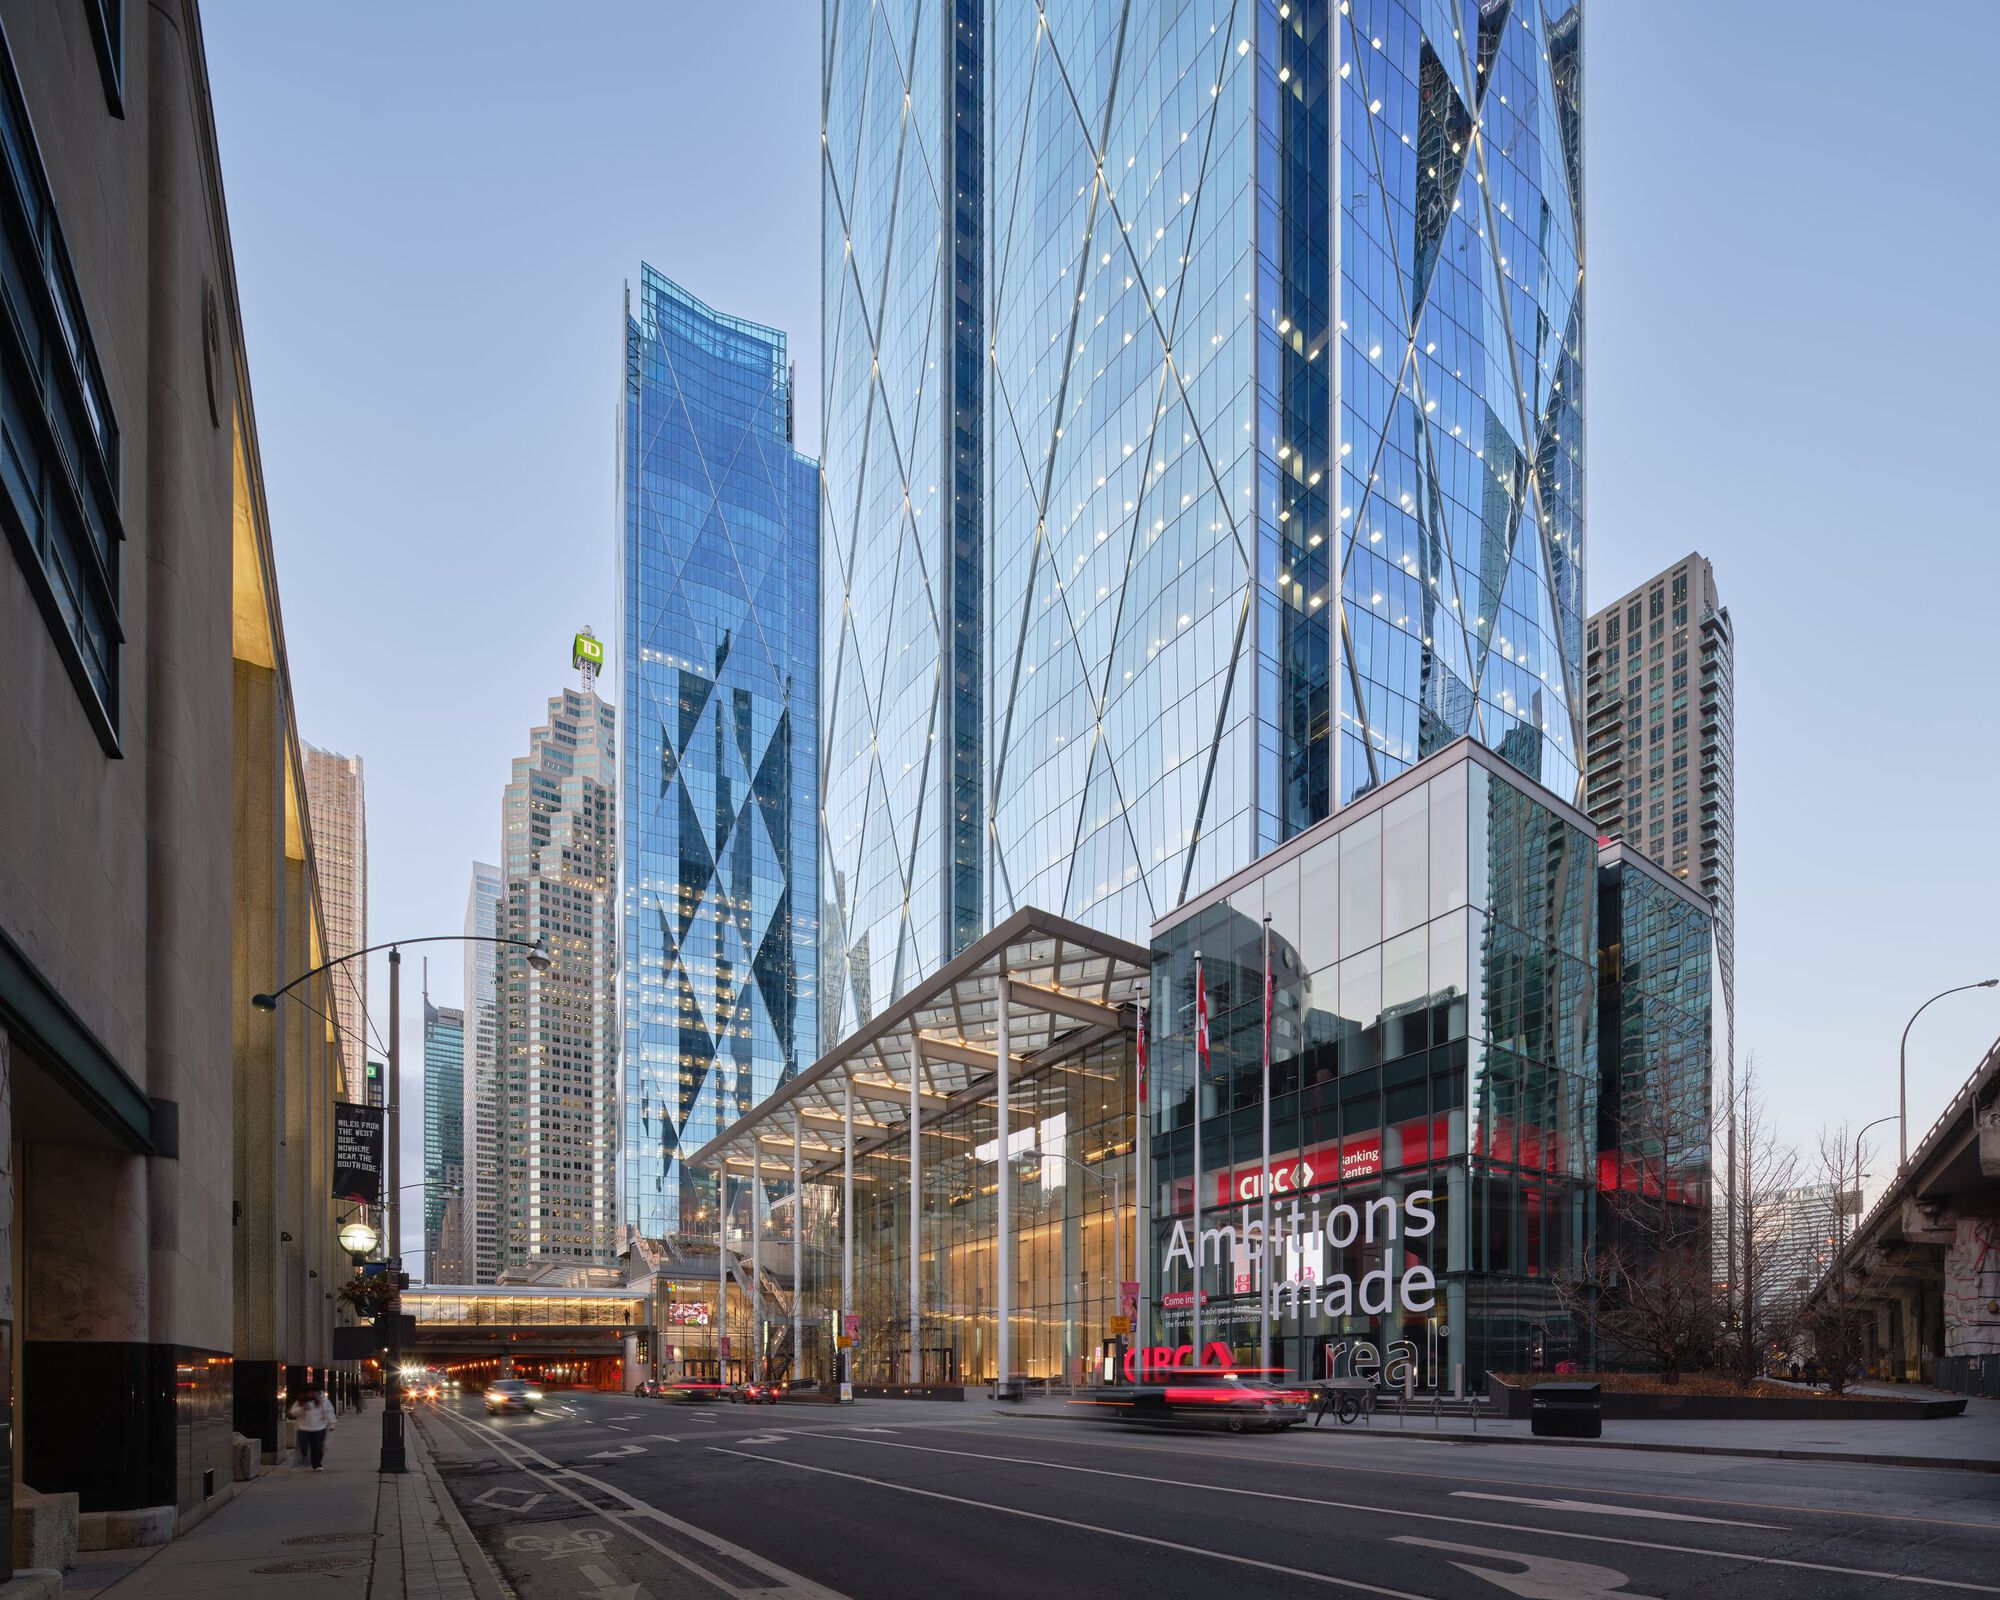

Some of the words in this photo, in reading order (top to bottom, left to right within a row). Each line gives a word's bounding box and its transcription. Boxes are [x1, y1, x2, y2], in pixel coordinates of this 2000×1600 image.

[579, 638, 601, 658] TD
[338, 1120, 360, 1128] MILES
[338, 1145, 370, 1154] NOWHERE
[1342, 1149, 1379, 1165] anking
[337, 1161, 360, 1169] SOUTH
[359, 1154, 372, 1162] THE
[1239, 1168, 1289, 1200] CIBC
[1163, 1189, 1436, 1272] Ambitions
[1272, 1247, 1436, 1322] made
[1164, 1296, 1184, 1306] Come
[1185, 1292, 1206, 1304] inse
[1200, 1317, 1218, 1326] oward
[1218, 1318, 1230, 1326] your
[1325, 1316, 1438, 1388] real
